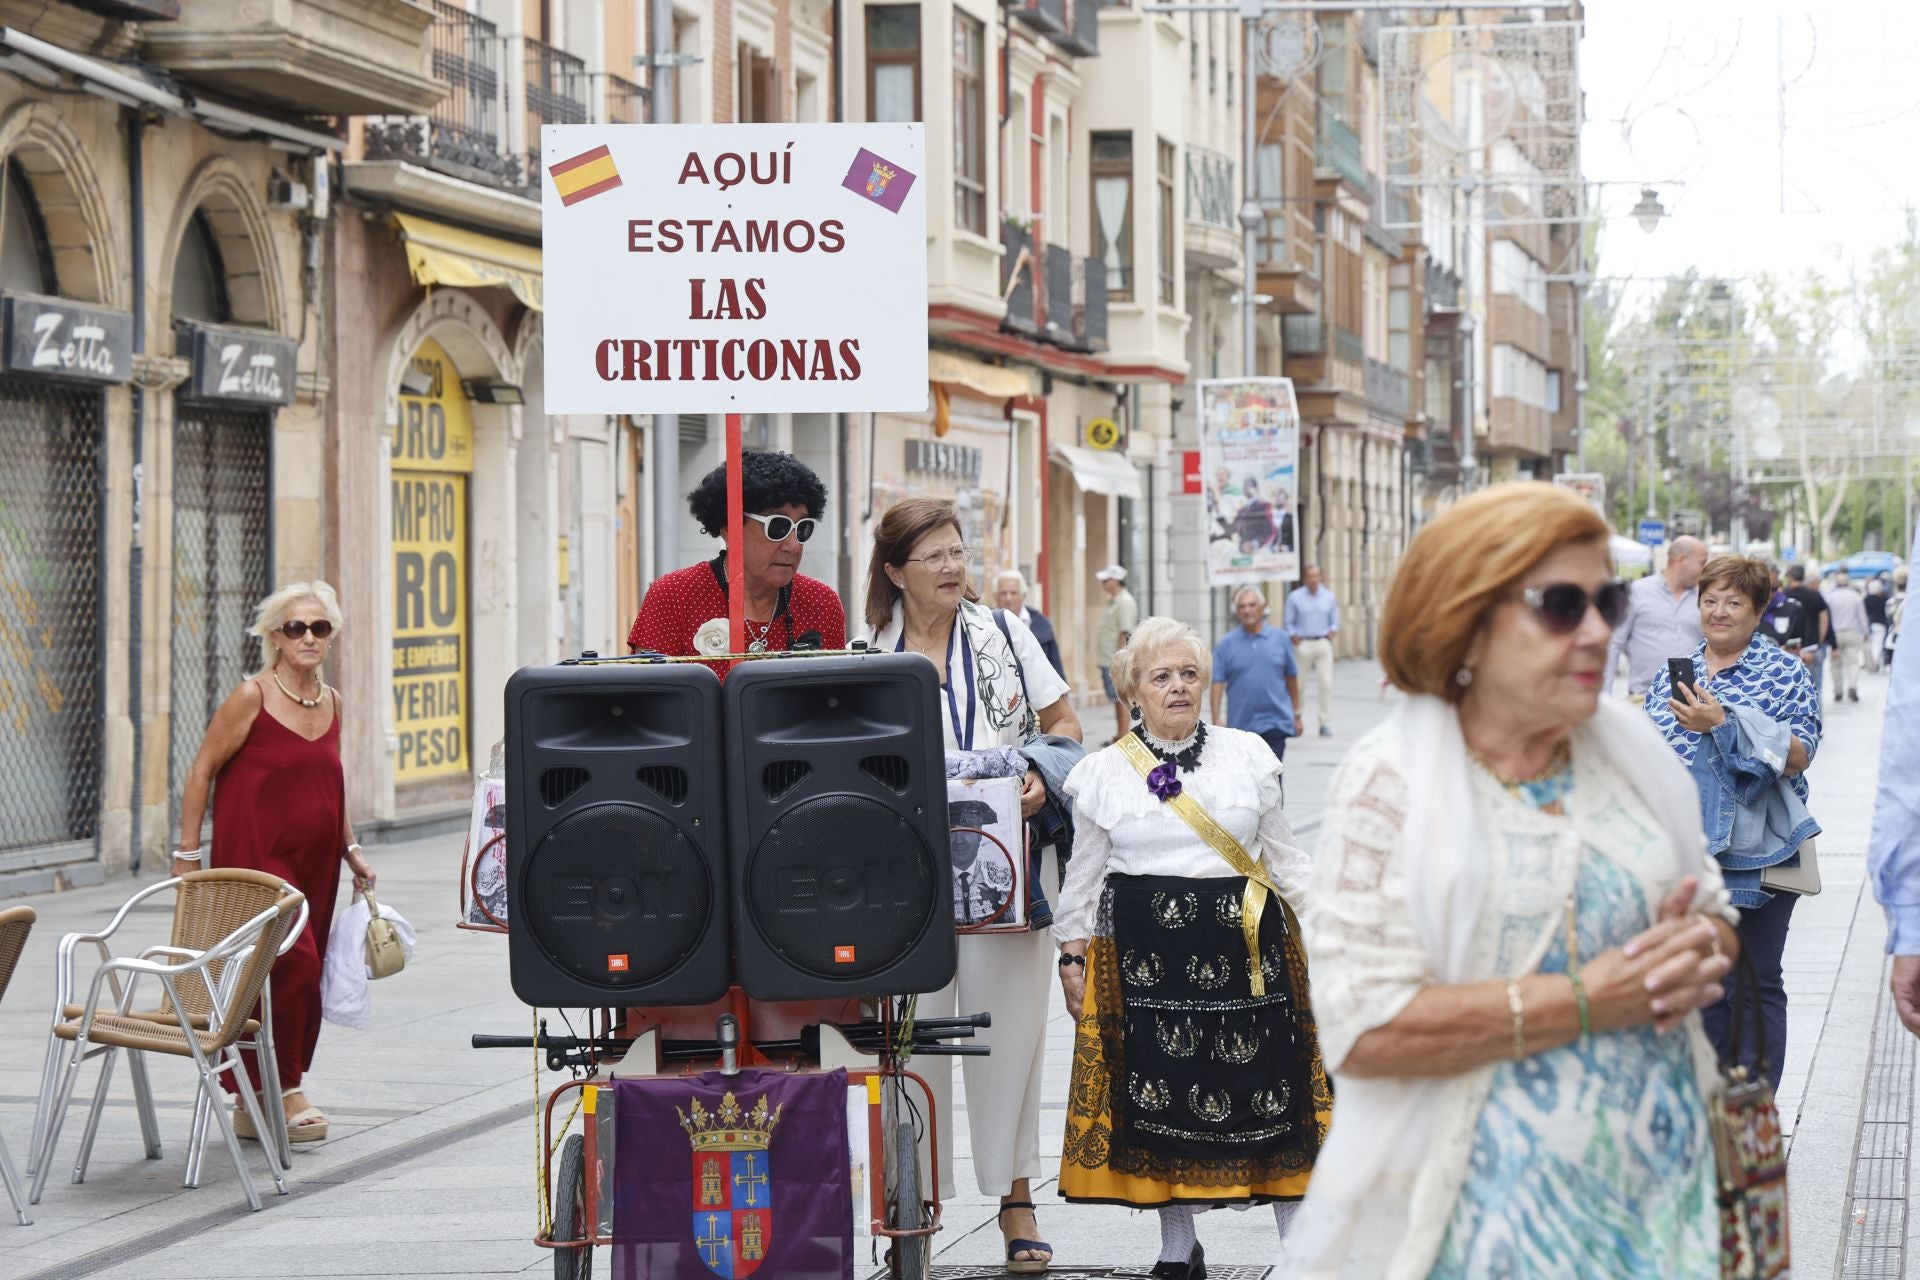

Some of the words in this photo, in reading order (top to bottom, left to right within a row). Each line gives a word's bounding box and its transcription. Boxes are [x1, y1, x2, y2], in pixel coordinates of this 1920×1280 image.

[677, 141, 796, 191] AQUÍ
[627, 218, 846, 254] ESTAMOS
[688, 277, 768, 321] LAS
[32, 313, 114, 375] Zetta
[594, 338, 862, 382] CRITICONAS
[218, 344, 283, 398] Zetta
[399, 726, 461, 770] PESO
